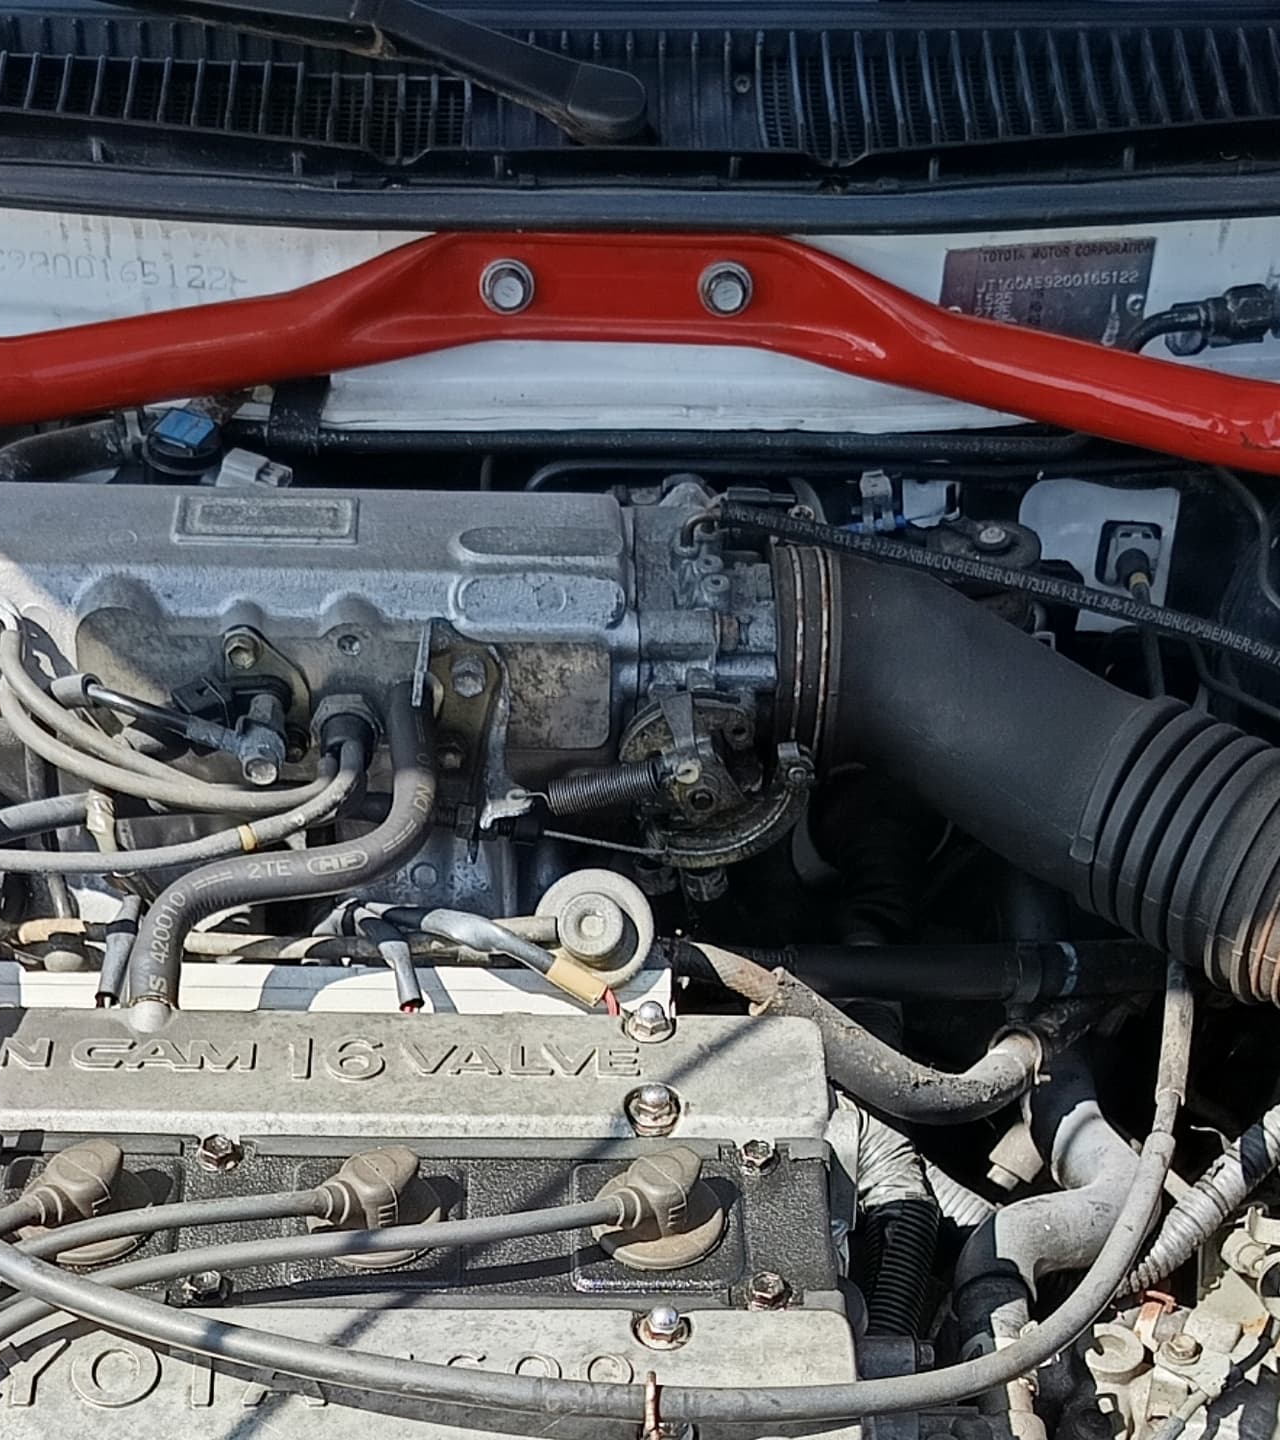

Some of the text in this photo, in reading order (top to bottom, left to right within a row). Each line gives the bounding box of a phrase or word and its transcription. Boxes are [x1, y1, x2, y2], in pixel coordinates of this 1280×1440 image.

[979, 241, 1151, 263] TOYOTA MOTOR CORPORATION
[414, 783, 434, 813] DN
[247, 859, 292, 880] 2TE
[150, 891, 186, 963] 420010
[72, 1038, 257, 1073] CAM
[289, 1036, 387, 1084] 16
[401, 1042, 644, 1079] VALVE
